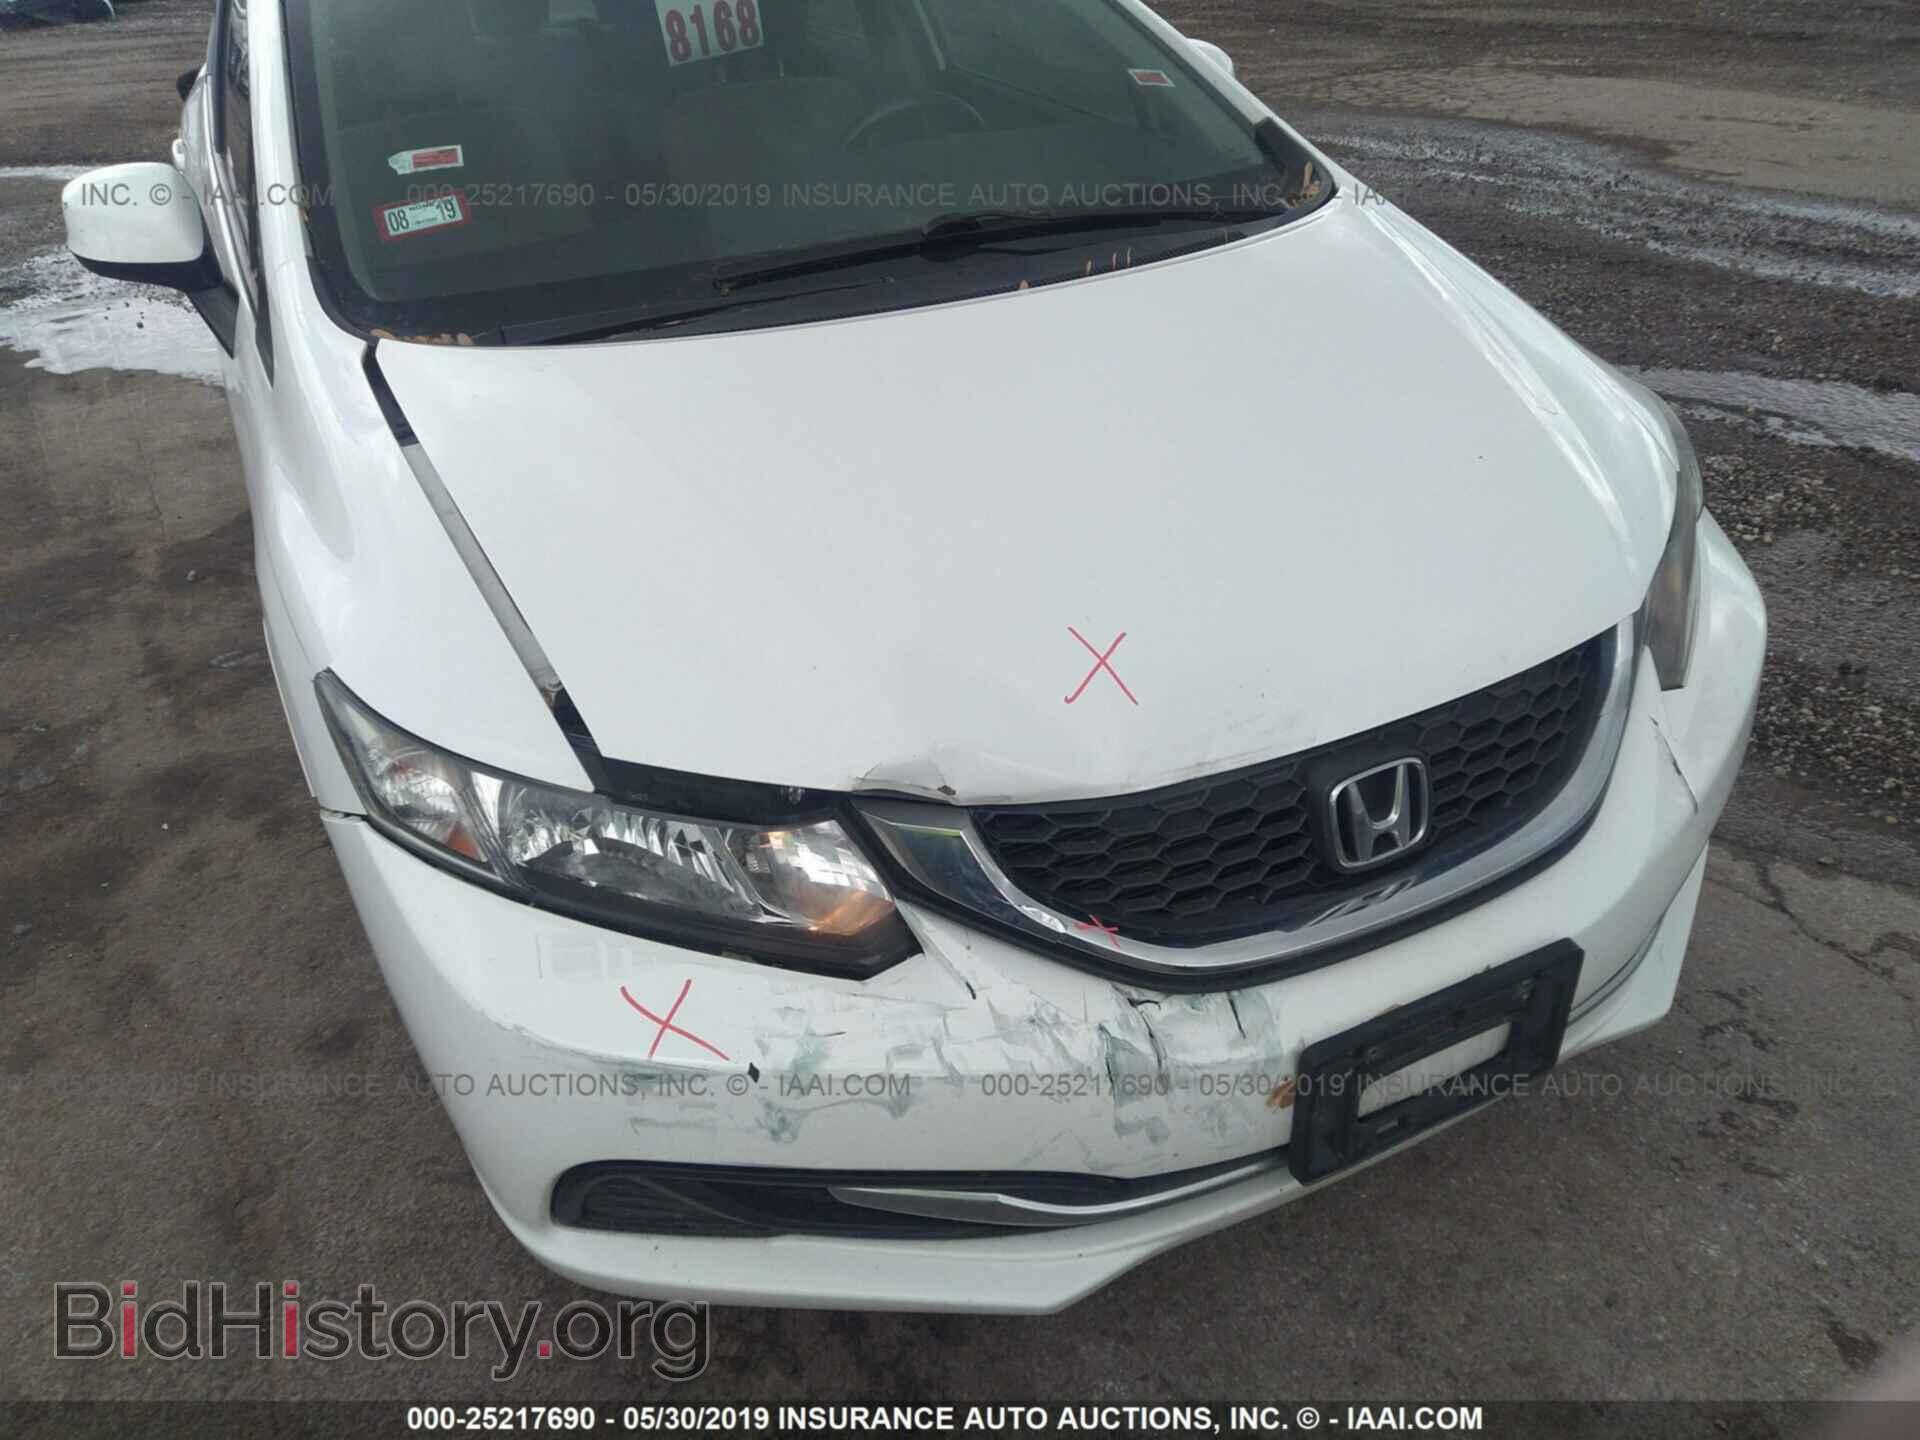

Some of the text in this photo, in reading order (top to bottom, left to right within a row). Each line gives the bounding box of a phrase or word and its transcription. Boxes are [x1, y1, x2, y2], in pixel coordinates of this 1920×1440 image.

[664, 0, 761, 61] 8168
[387, 209, 410, 233] 08
[436, 196, 457, 221] 19
